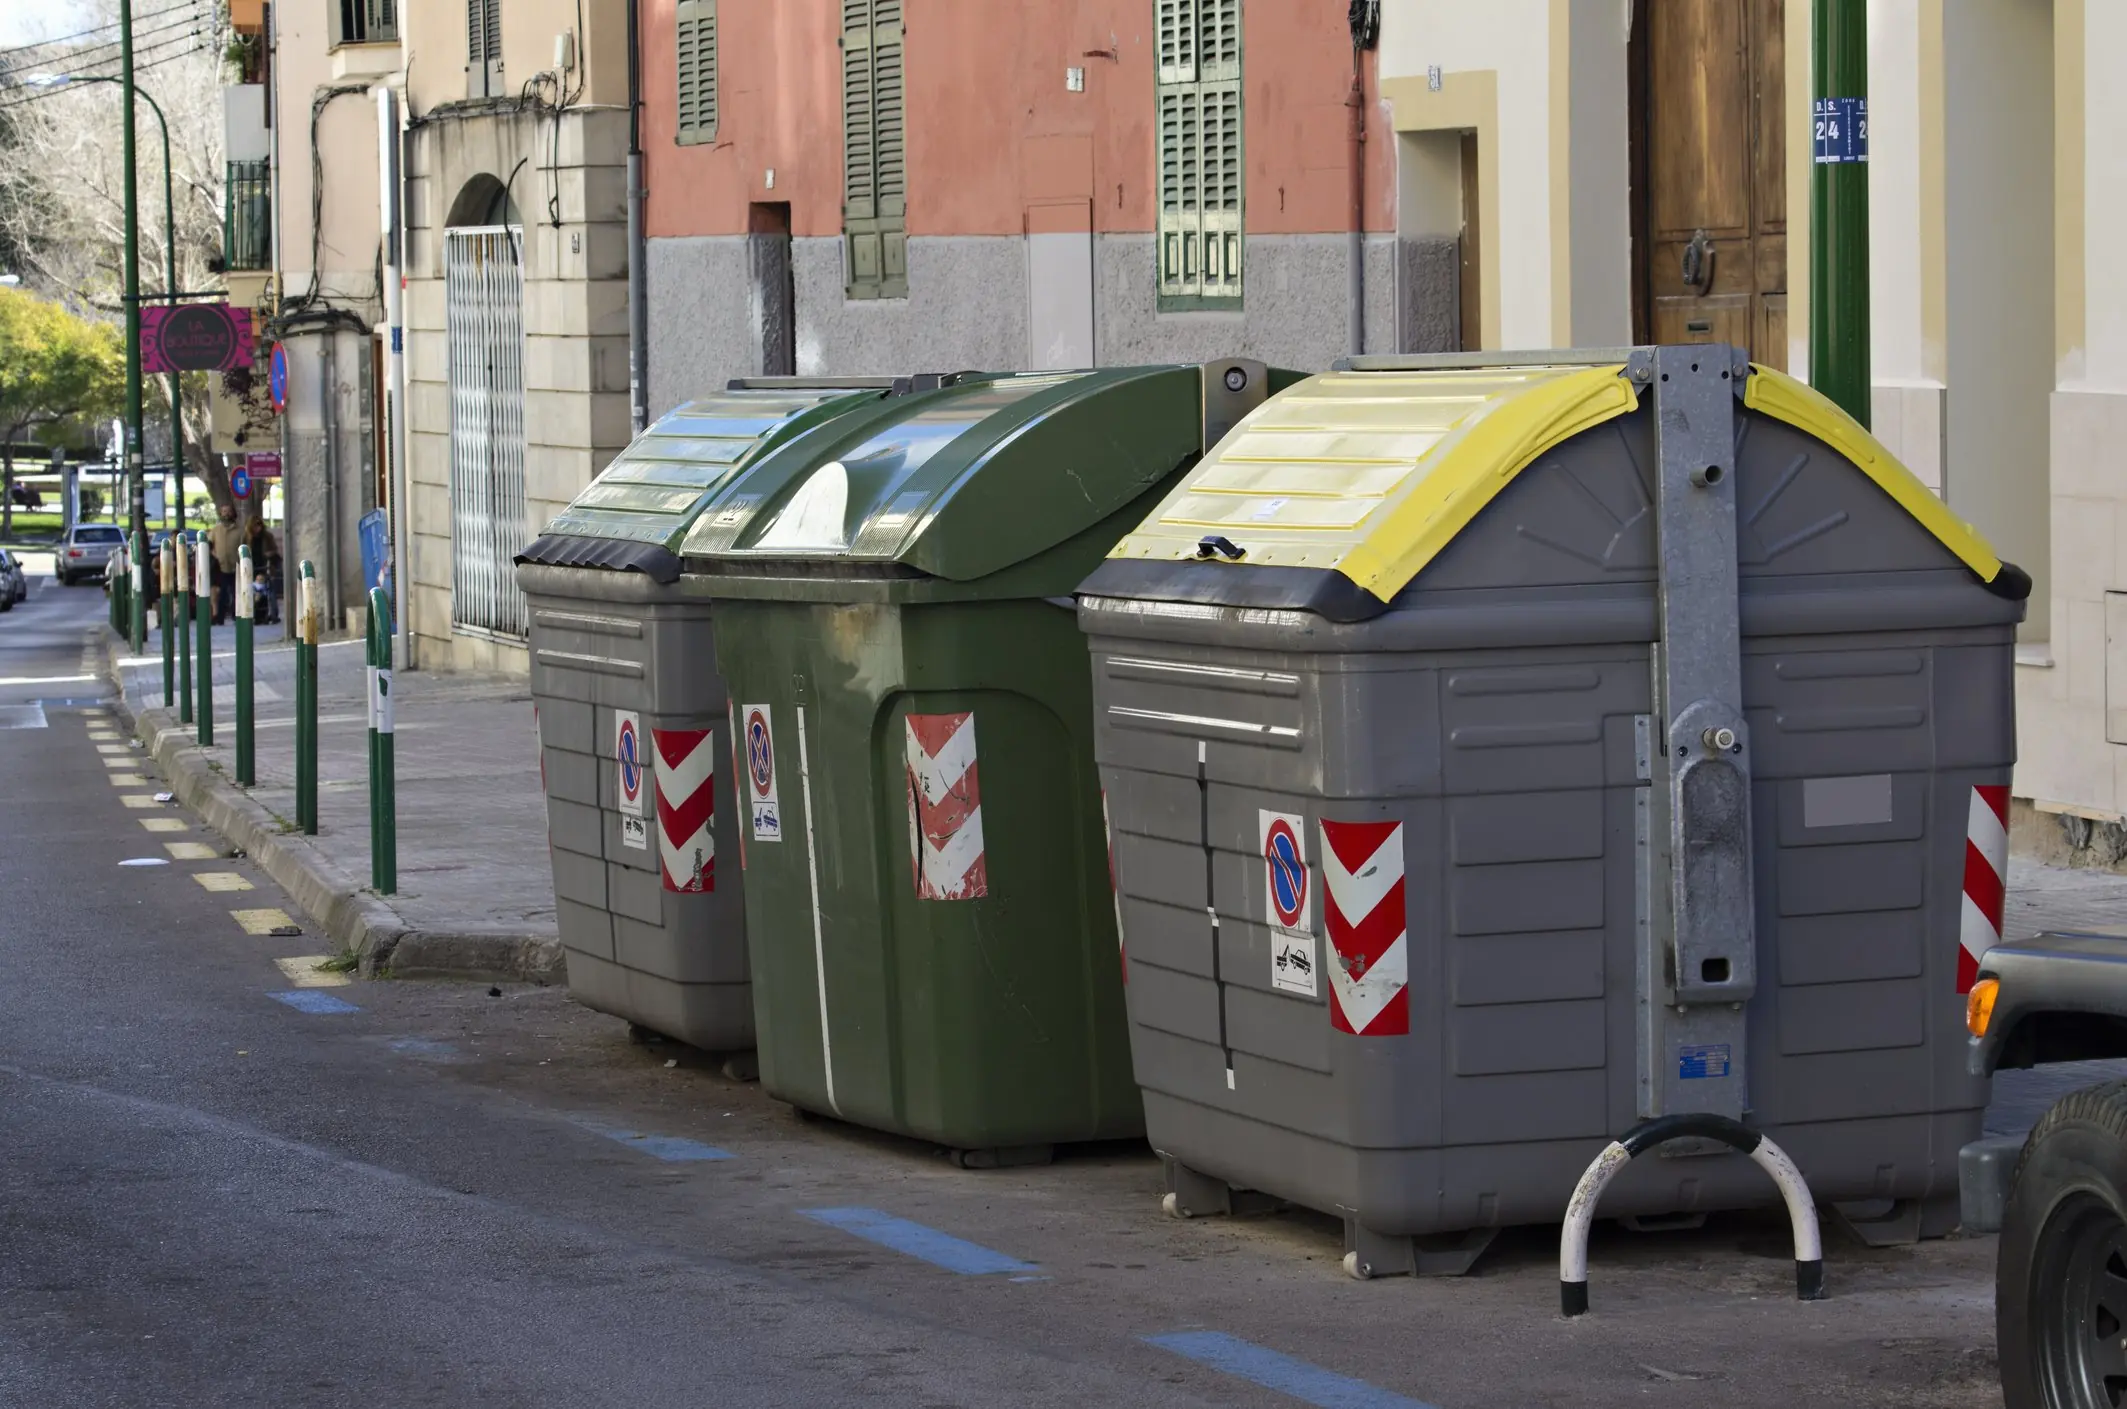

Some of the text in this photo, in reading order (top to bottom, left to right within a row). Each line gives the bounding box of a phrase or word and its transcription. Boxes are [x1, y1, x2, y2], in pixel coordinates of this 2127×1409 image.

[1828, 101, 1836, 111] S.
[188, 320, 205, 332] LA
[166, 332, 227, 349] BOUTIQUE
